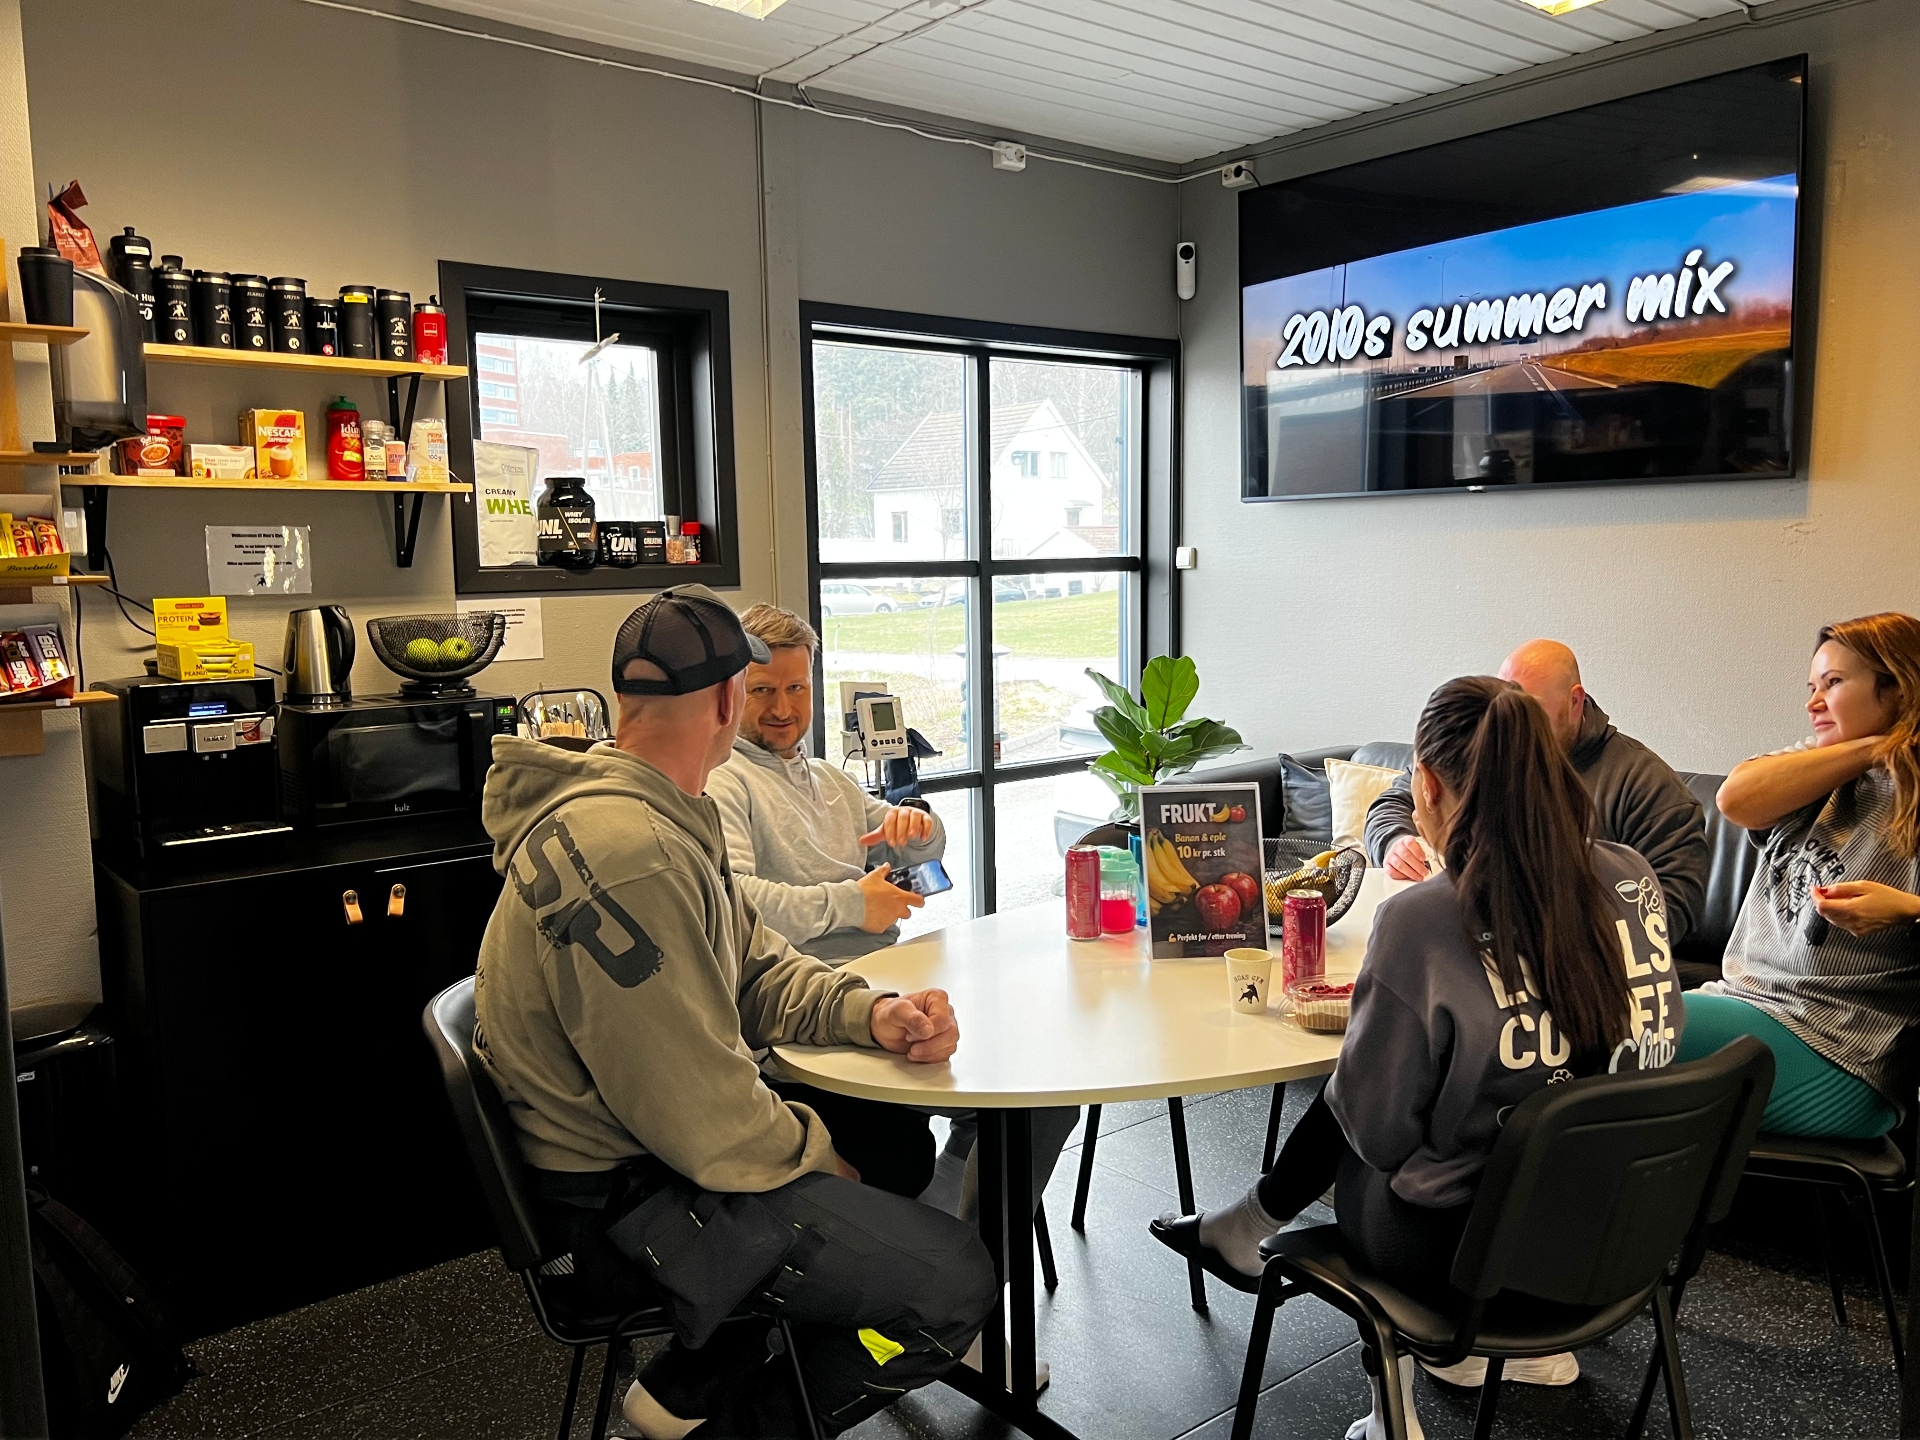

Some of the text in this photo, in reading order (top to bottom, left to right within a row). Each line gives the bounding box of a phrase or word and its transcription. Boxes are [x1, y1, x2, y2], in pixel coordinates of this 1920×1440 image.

[1278, 249, 1734, 369] 2010s summer mix
[157, 615, 194, 623] PROTEIN
[394, 803, 410, 812] kulz
[1160, 803, 1217, 824] FRUKT
[1174, 831, 1227, 844] Banan & eple
[1176, 845, 1226, 860] 10 kr pr. stk
[1176, 932, 1198, 943] Perfekt
[1207, 932, 1212, 941] /
[1211, 933, 1225, 941] etter
[1225, 931, 1246, 941] trening
[1607, 1019, 1676, 1075] Club
[110, 1363, 125, 1392] NIKE
